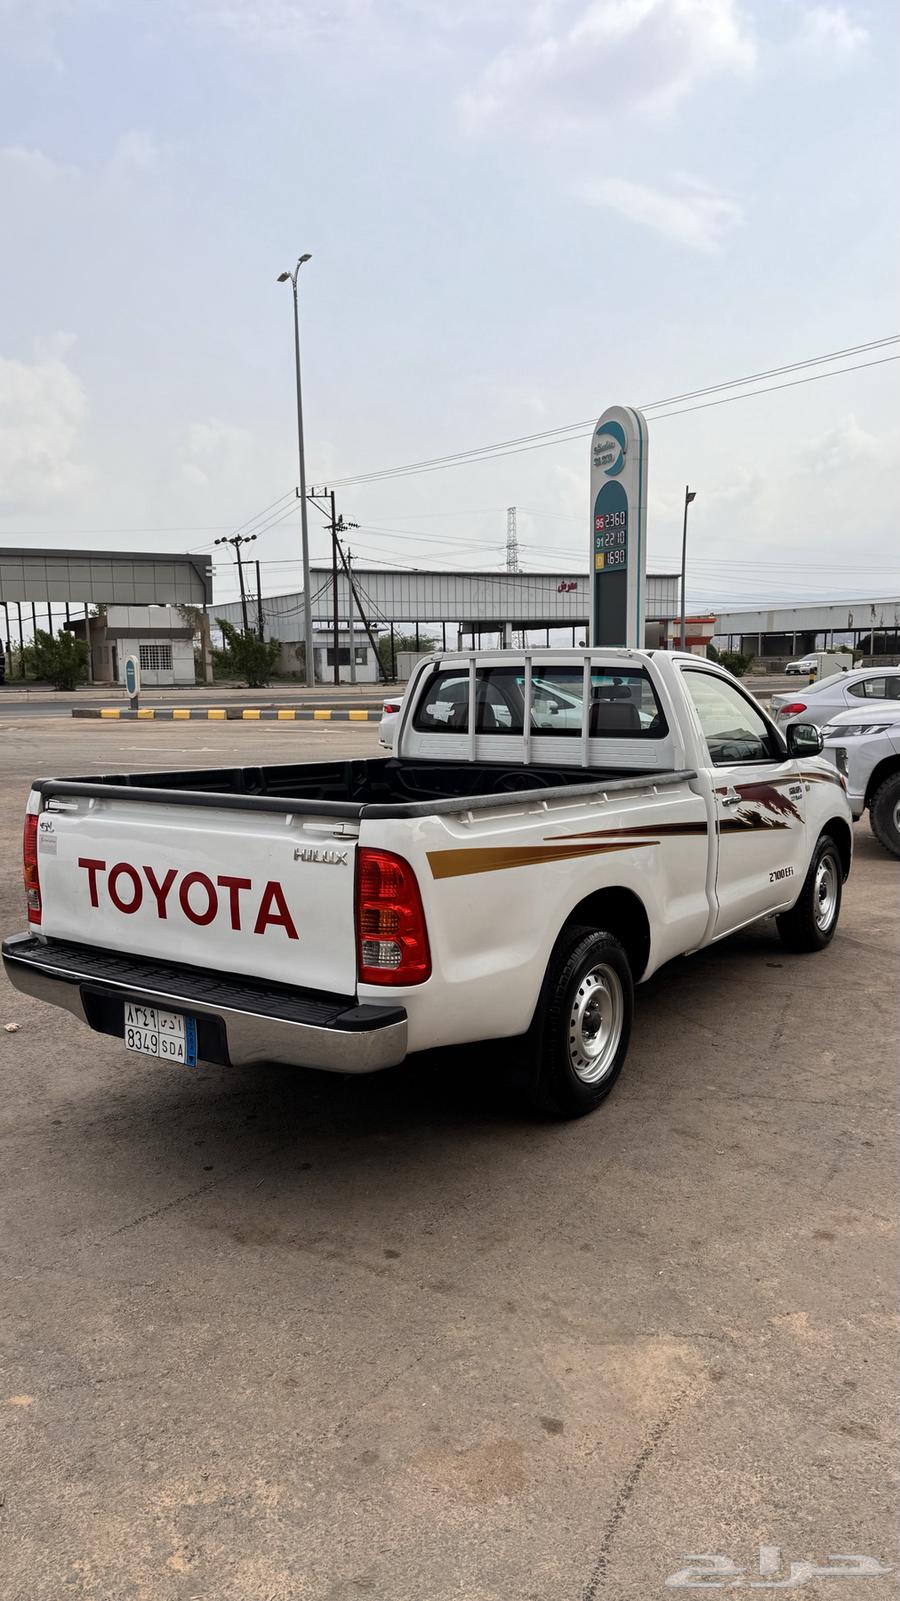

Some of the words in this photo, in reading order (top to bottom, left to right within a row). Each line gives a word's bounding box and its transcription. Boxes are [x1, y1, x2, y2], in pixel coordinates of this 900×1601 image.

[595, 518, 604, 529] 95
[605, 511, 625, 528] 2360
[596, 537, 604, 548] 91
[605, 531, 625, 546] 2210
[607, 550, 625, 564] 1690
[293, 848, 348, 866] HILUX
[769, 868, 785, 882] 2700
[78, 857, 299, 940] TOYOTA
[127, 1005, 157, 1029] ٨٣٤٩
[127, 1028, 158, 1054] 8349
[161, 1040, 183, 1058] SDA
